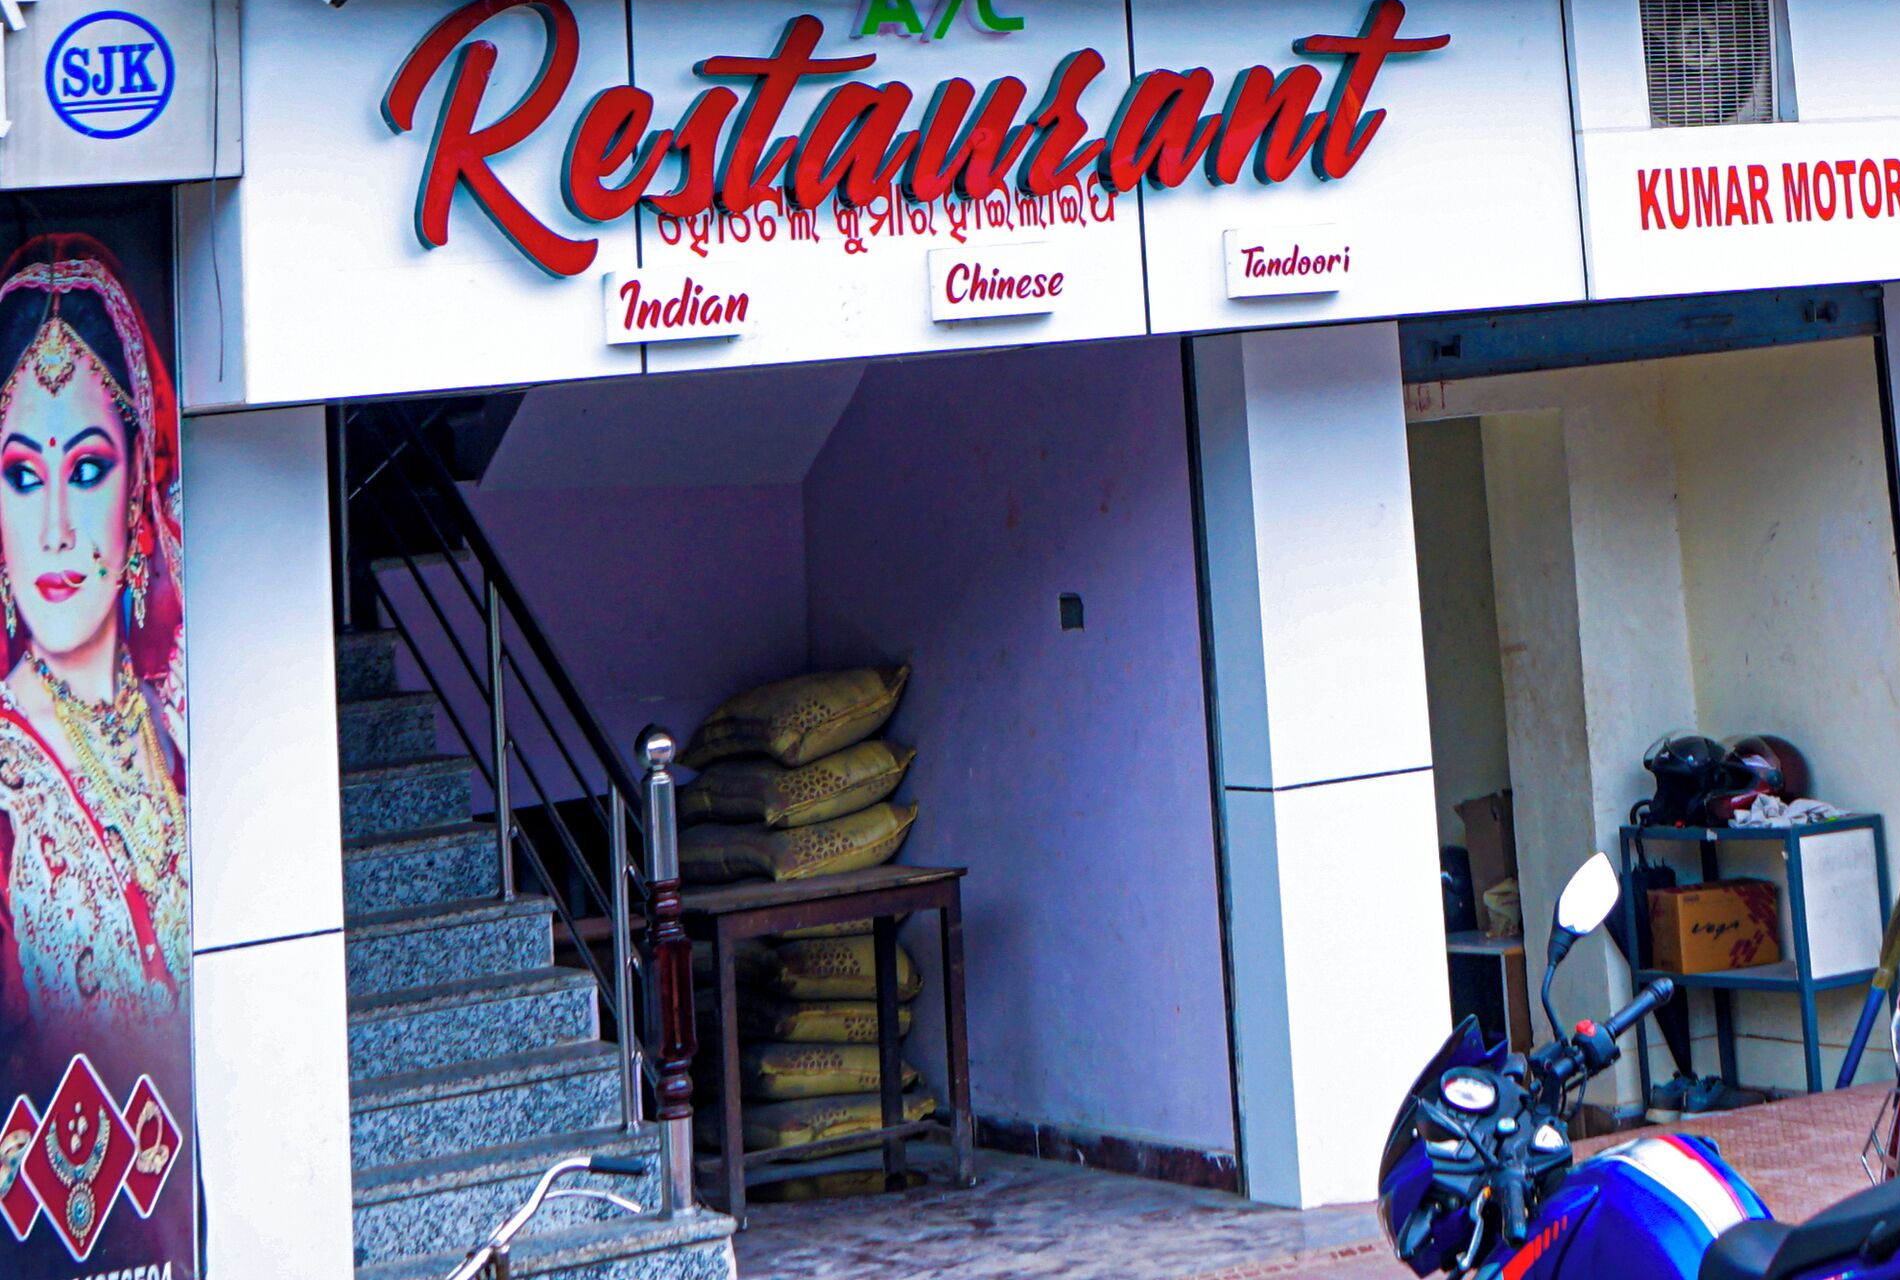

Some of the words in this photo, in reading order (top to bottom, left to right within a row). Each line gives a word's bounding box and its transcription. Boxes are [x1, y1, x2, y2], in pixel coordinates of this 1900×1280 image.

[61, 42, 158, 98] SJK
[1636, 164, 1774, 231] KUMAR
[944, 262, 1064, 305] Chinese
[1241, 244, 1351, 279] Tandoori
[619, 278, 750, 330] Indian
